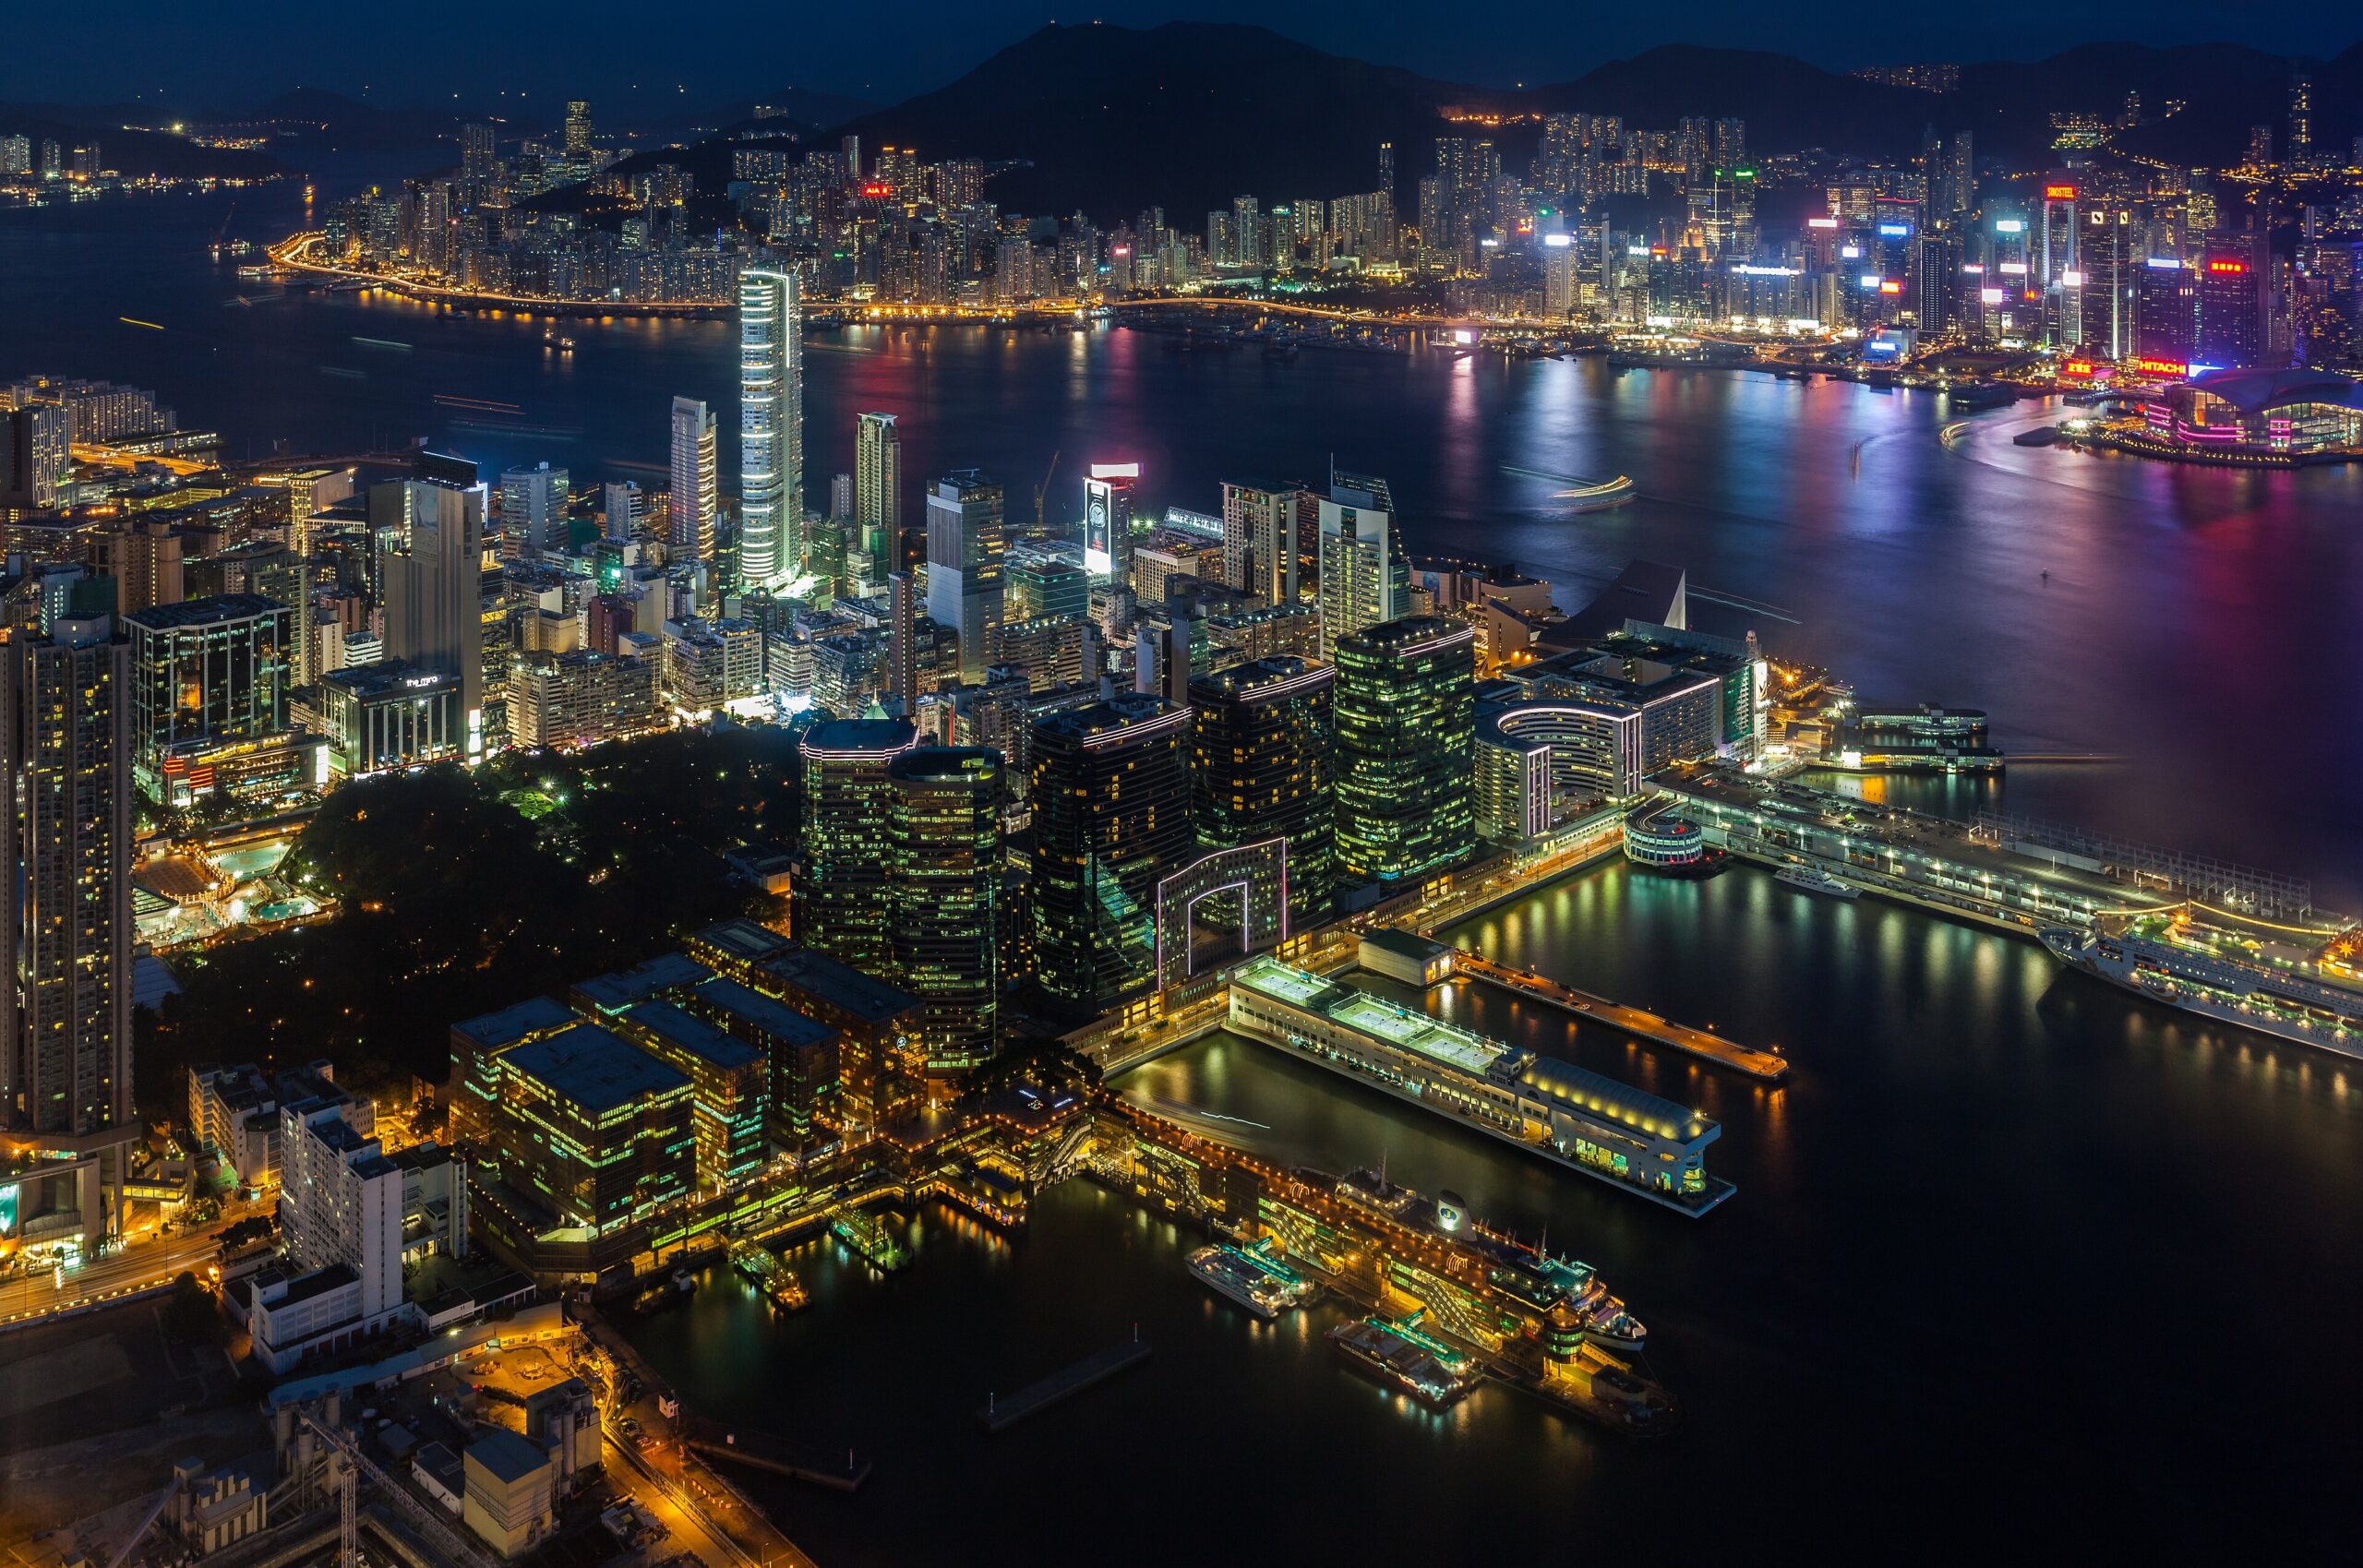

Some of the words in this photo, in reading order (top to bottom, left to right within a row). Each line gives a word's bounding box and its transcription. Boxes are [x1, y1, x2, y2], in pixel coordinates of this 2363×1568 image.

[2047, 187, 2073, 197] SINOSTEEL
[2140, 361, 2186, 374] HITACHI
[406, 678, 419, 687] the
[2309, 1026, 2333, 1043] STAR
